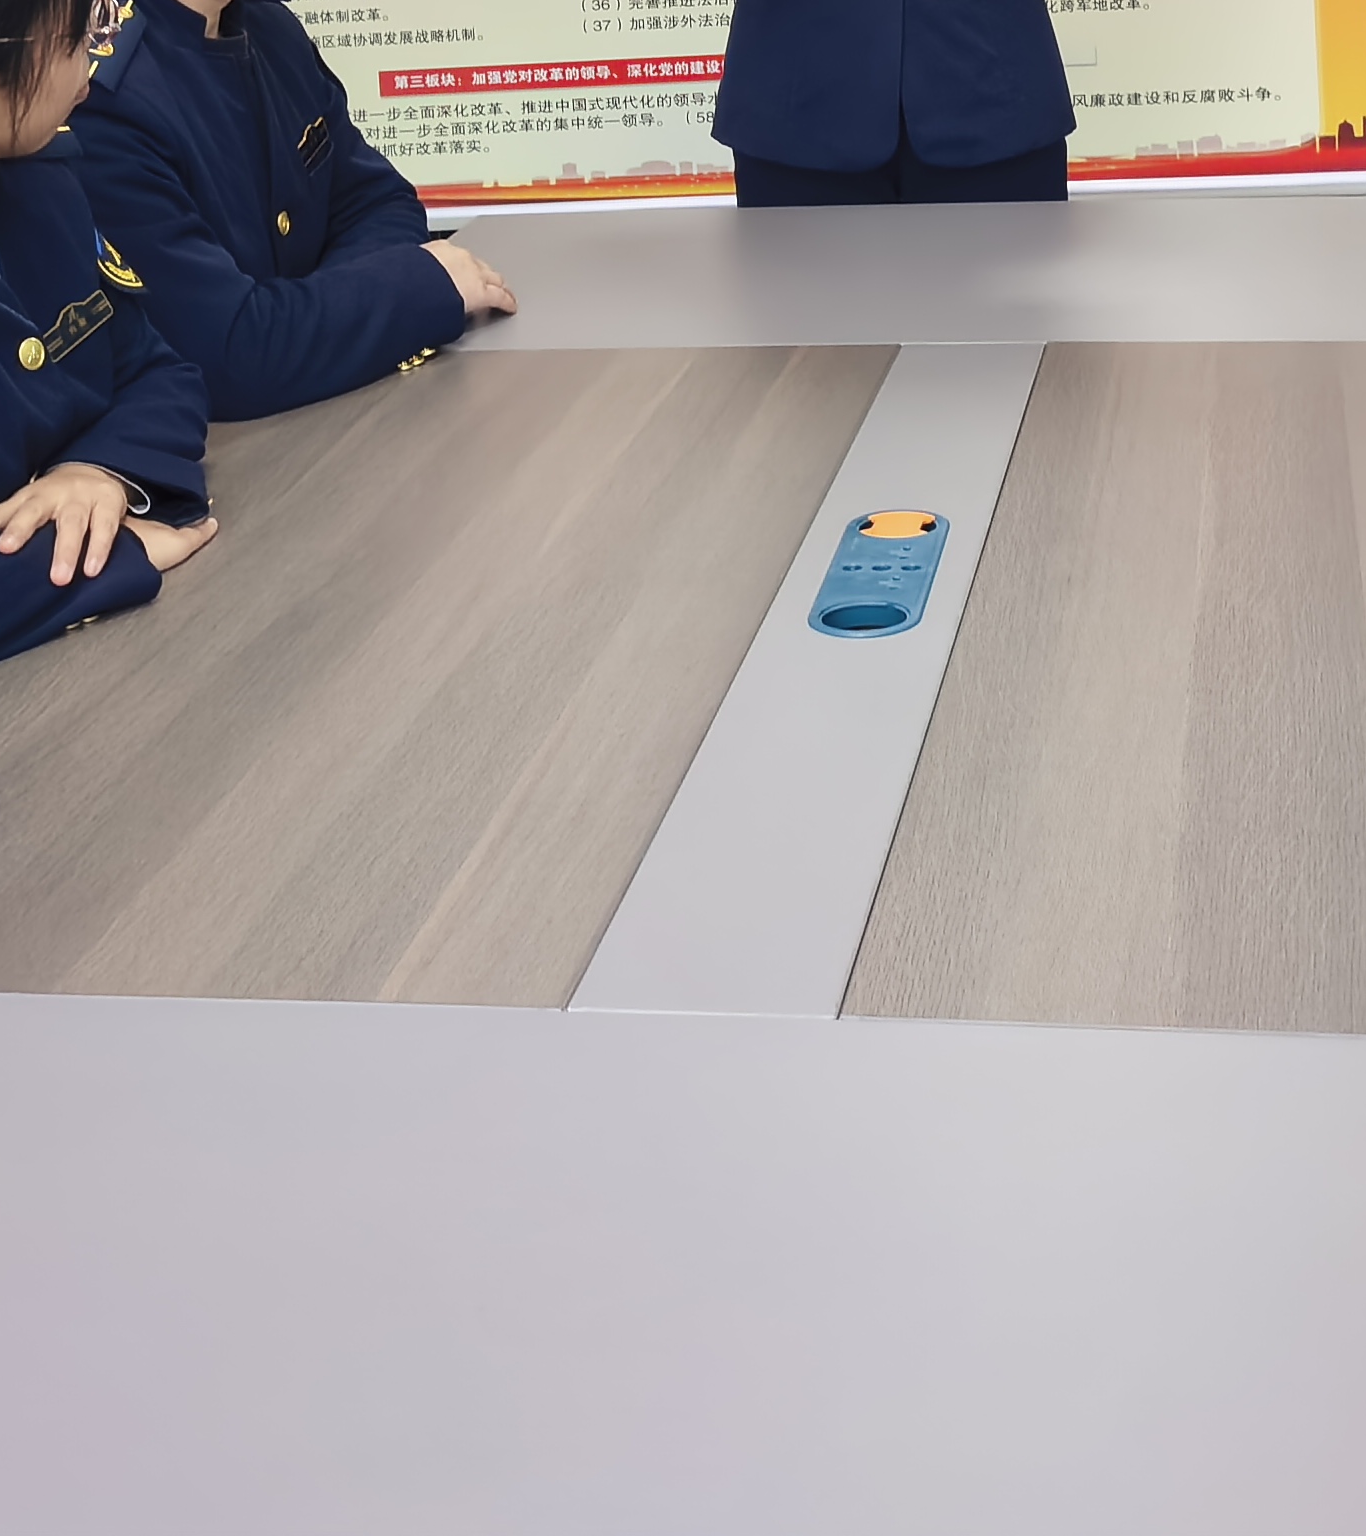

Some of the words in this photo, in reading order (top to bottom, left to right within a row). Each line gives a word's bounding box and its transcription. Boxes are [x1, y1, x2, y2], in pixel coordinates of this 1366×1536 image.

[393, 59, 724, 90] 第三板块：加强党对改革的领导、深化党的建设
[1072, 87, 1282, 108] 风廉政建设和反腐败斗争。
